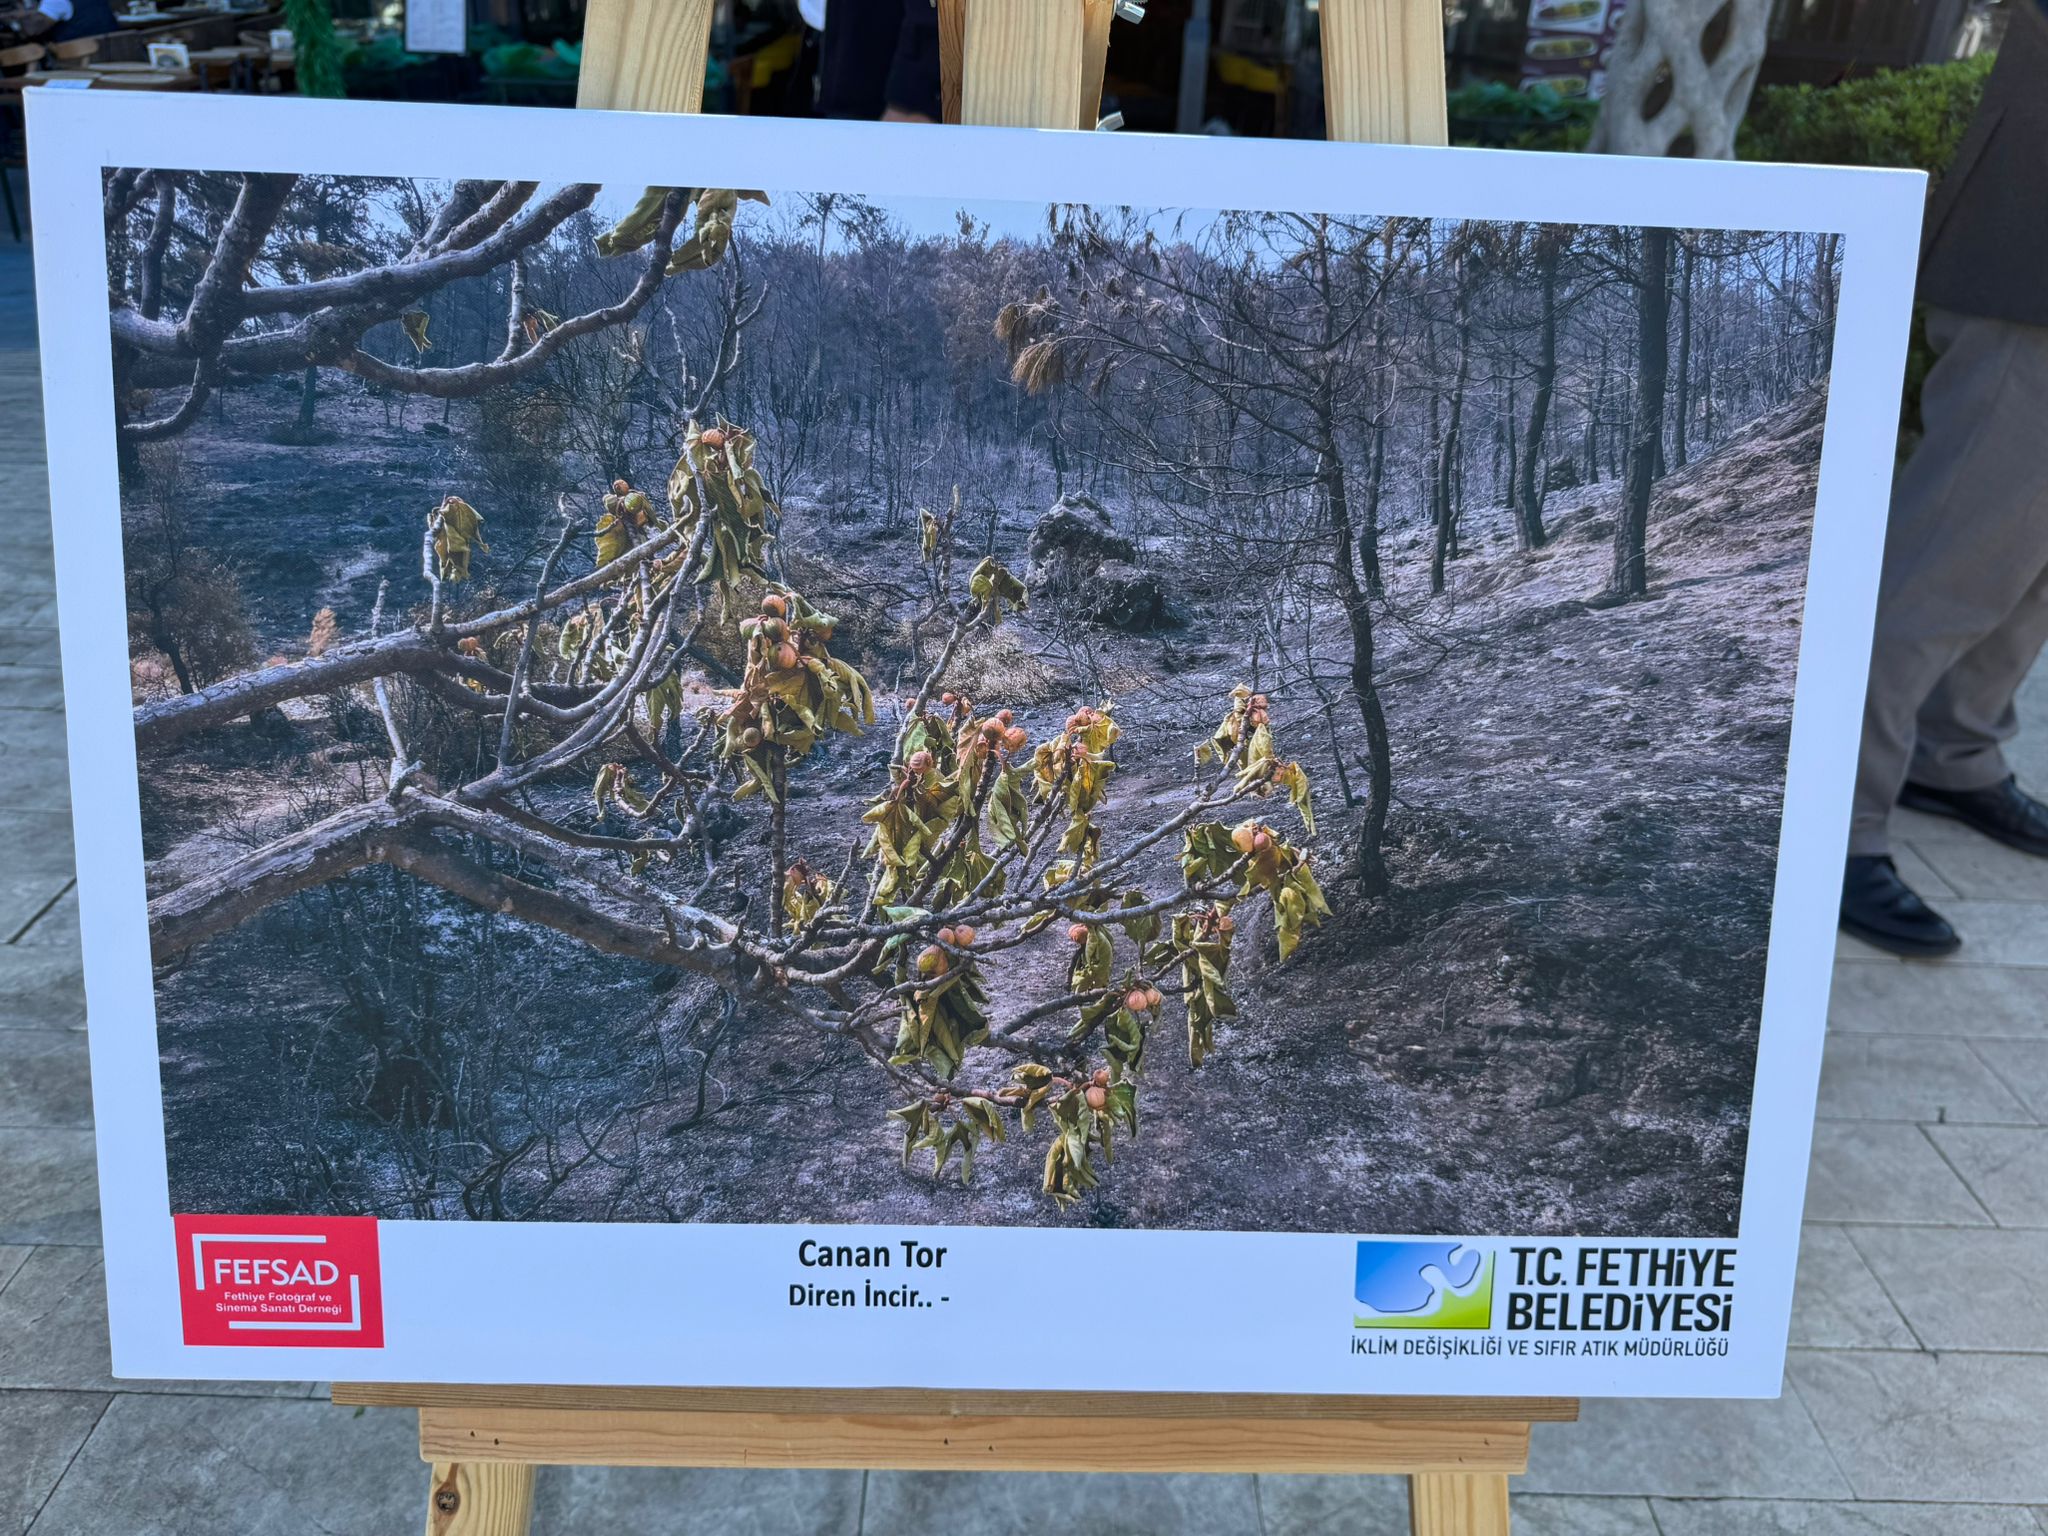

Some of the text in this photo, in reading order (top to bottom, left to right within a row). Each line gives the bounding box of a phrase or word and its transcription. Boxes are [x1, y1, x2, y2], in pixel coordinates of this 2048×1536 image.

[798, 1239, 947, 1268] Canan Tor
[214, 1258, 339, 1286] FEFSAD
[1510, 1246, 1567, 1286] T.C.
[224, 1292, 332, 1303] Fethiye Fotoğraf ve
[789, 1283, 856, 1306] Diren
[215, 1302, 342, 1315] Sinema Sanatı Derneği
[1350, 1336, 1729, 1360] İKLİM DEĞİŞİKLİĞİ VE SIFIR ATIK MÜDÜRLÜĞÜ
